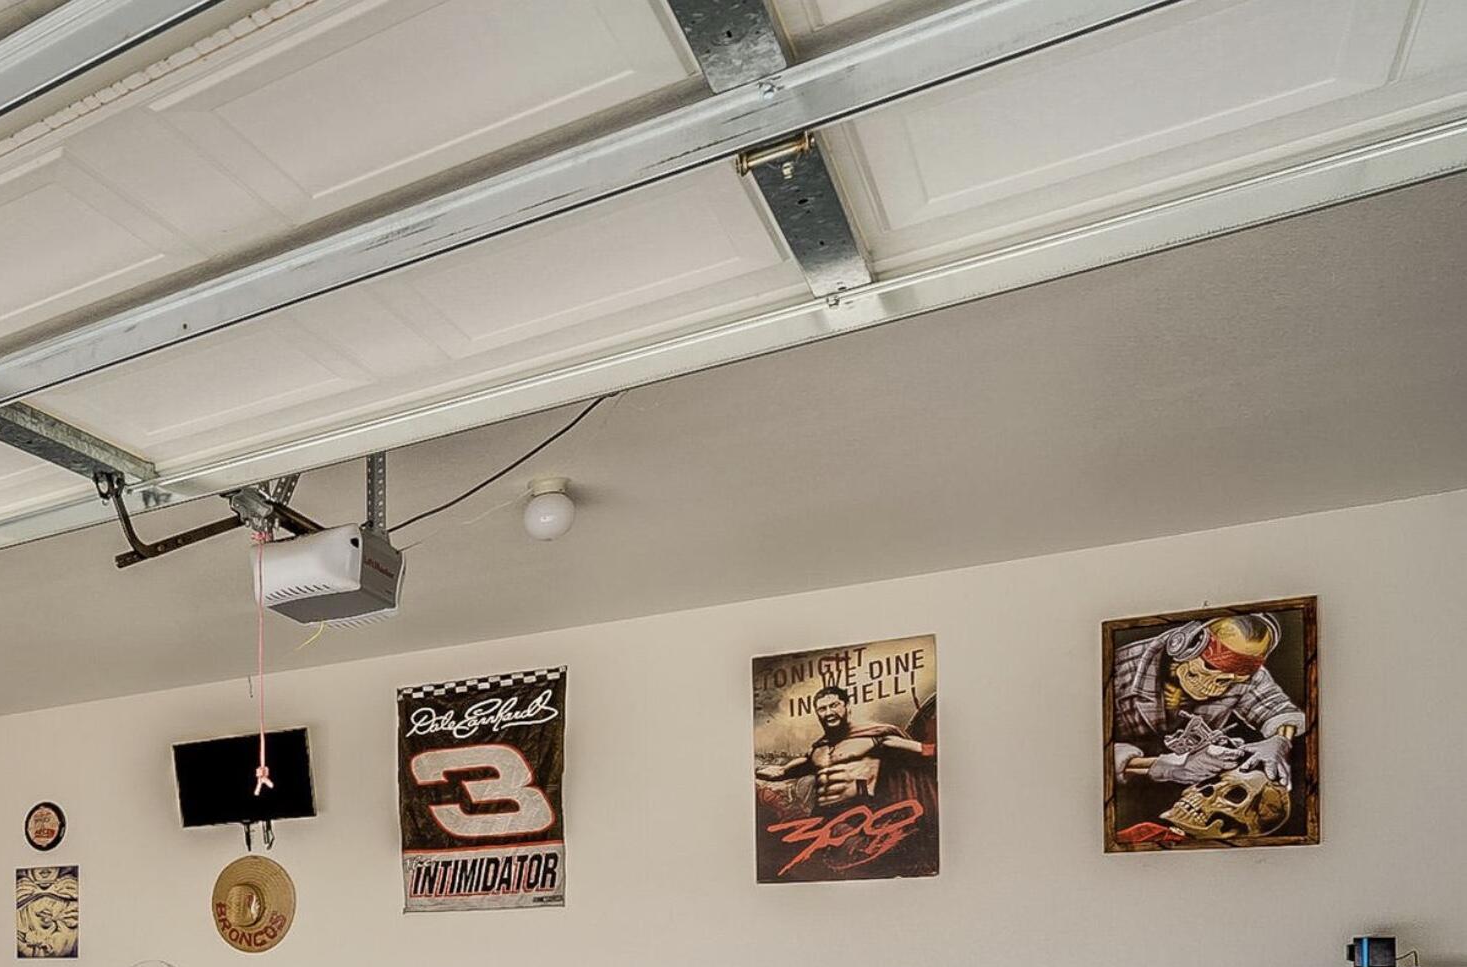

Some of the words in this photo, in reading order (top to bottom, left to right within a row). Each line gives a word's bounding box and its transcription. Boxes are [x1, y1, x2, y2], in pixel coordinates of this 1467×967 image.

[761, 647, 867, 691] TONIGHT
[821, 664, 857, 688] WE
[869, 649, 925, 681] DINE
[789, 695, 811, 717] IN
[848, 670, 915, 705] HELL!
[406, 707, 457, 737] Dale
[410, 743, 556, 839] 3
[767, 800, 924, 877] 300
[410, 852, 559, 897] INTIMIDATOR
[215, 901, 287, 947] BRONCOS
